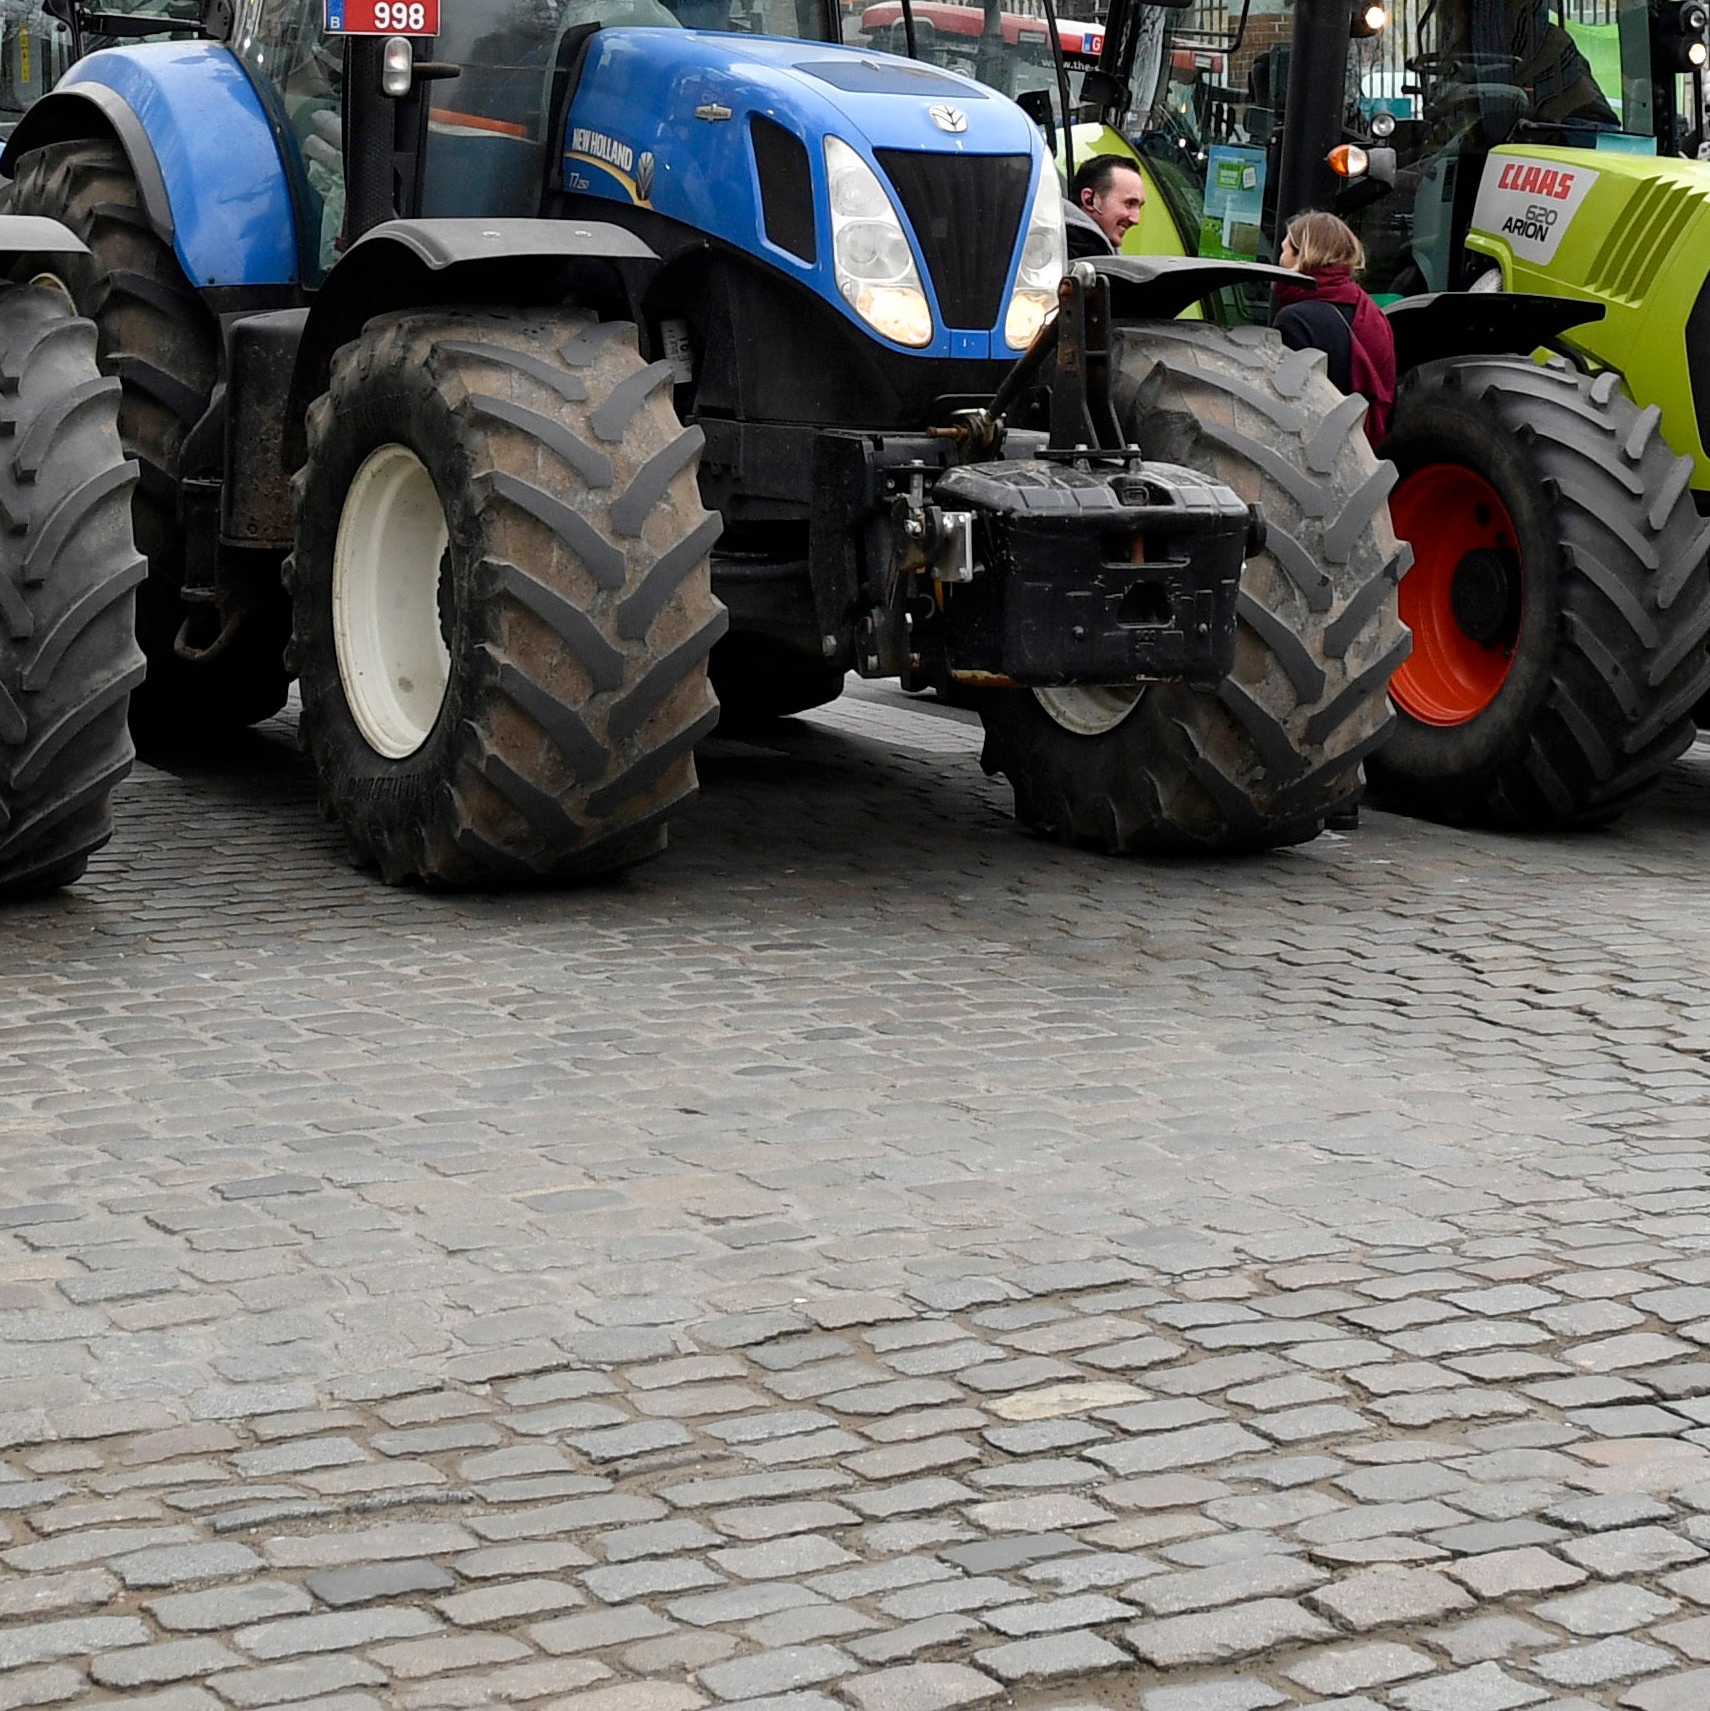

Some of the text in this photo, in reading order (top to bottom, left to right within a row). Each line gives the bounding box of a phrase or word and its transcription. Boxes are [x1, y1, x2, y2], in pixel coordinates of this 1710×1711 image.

[330, 16, 341, 29] B
[374, 1, 425, 30] 998
[572, 128, 634, 173] NEW HOLLAND
[1497, 163, 1576, 201] CLAAS
[1525, 204, 1559, 226] 620
[1501, 216, 1549, 242] ARION
